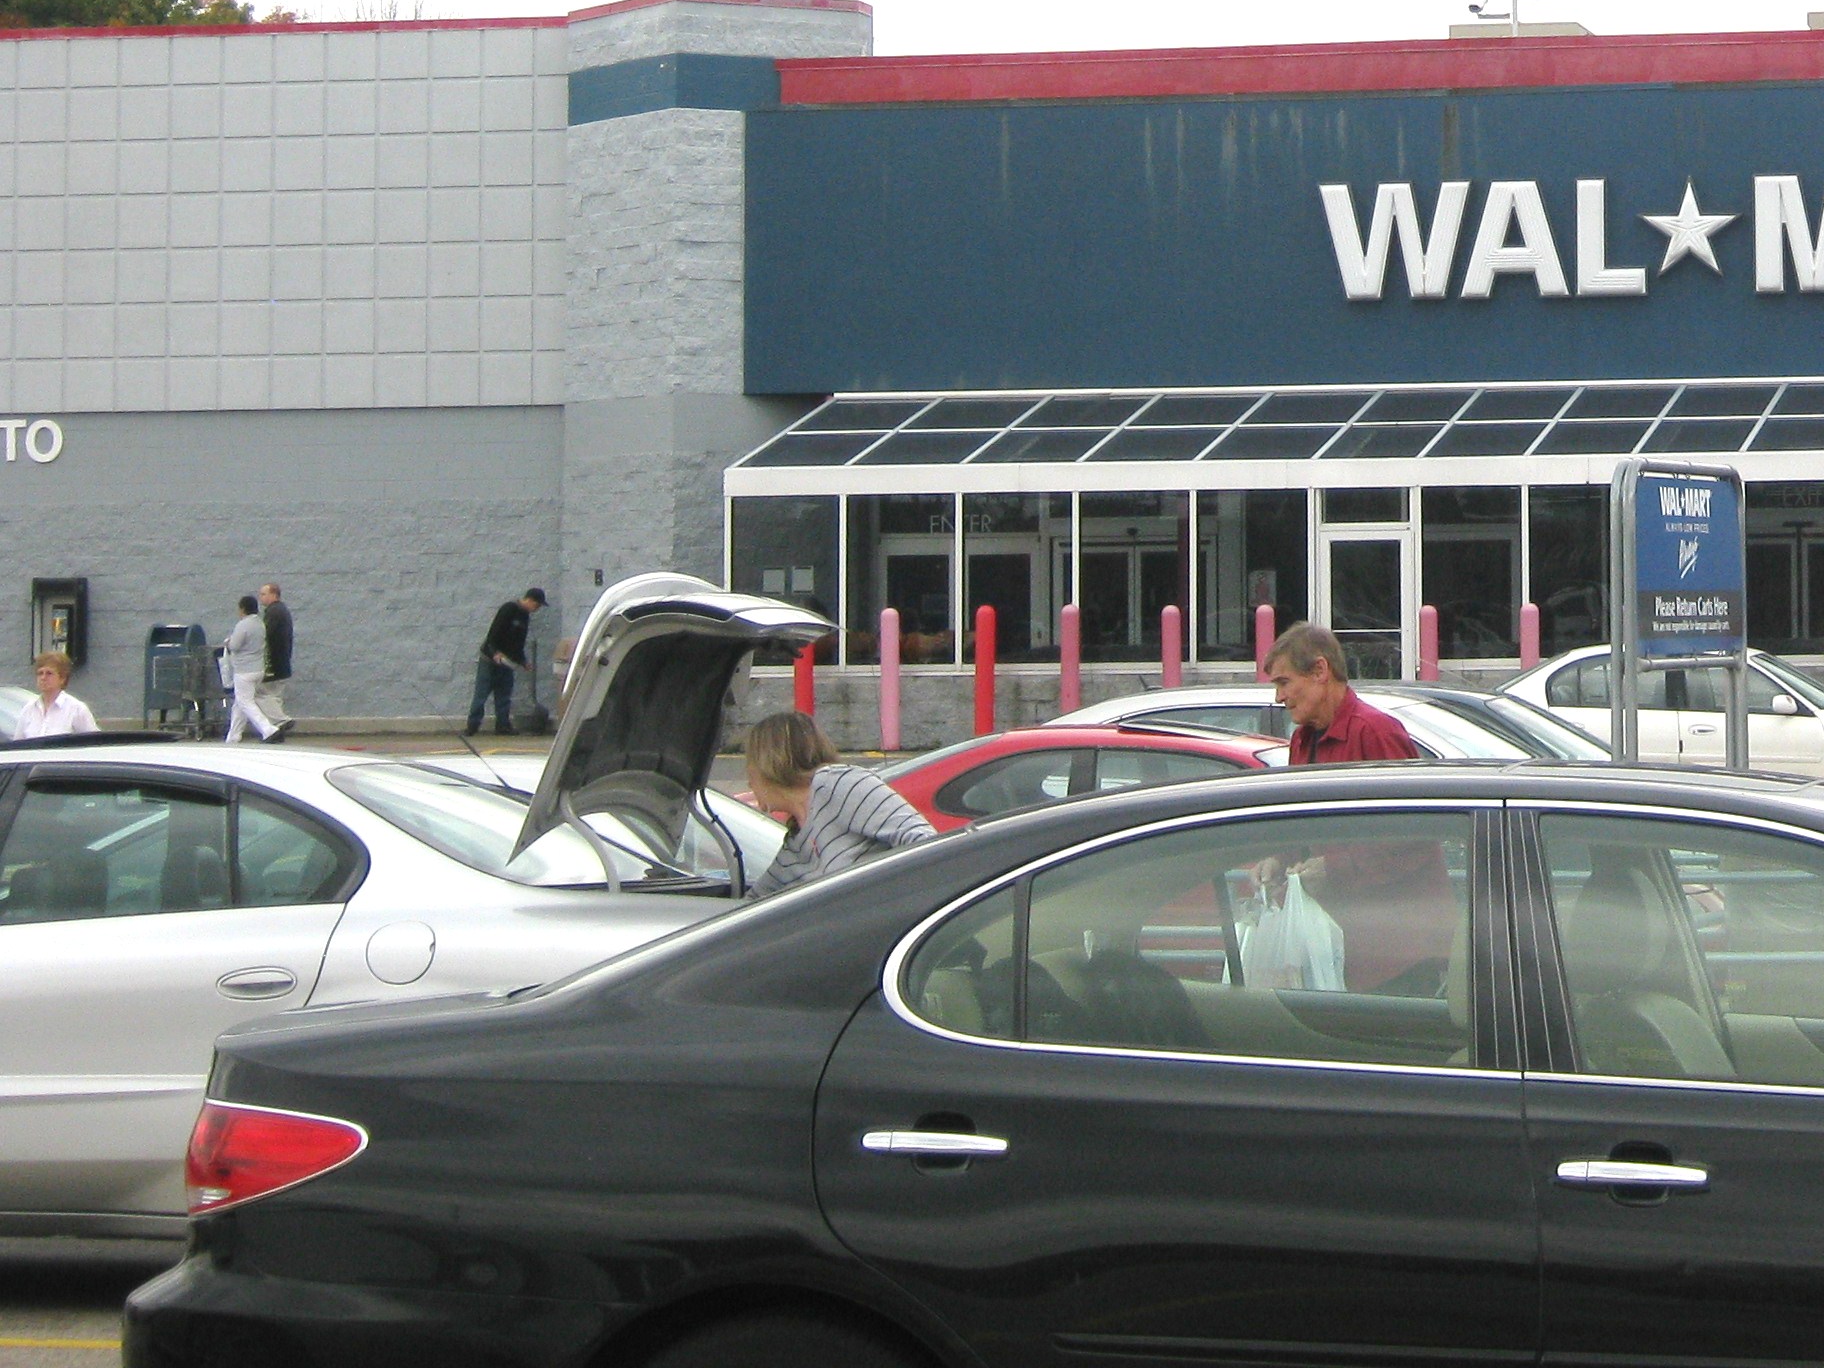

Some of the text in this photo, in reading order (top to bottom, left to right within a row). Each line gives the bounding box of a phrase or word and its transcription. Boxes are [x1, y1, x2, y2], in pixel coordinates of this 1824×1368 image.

[930, 514, 992, 534] ENER
[1655, 596, 1729, 616] Please Return Carts Here
